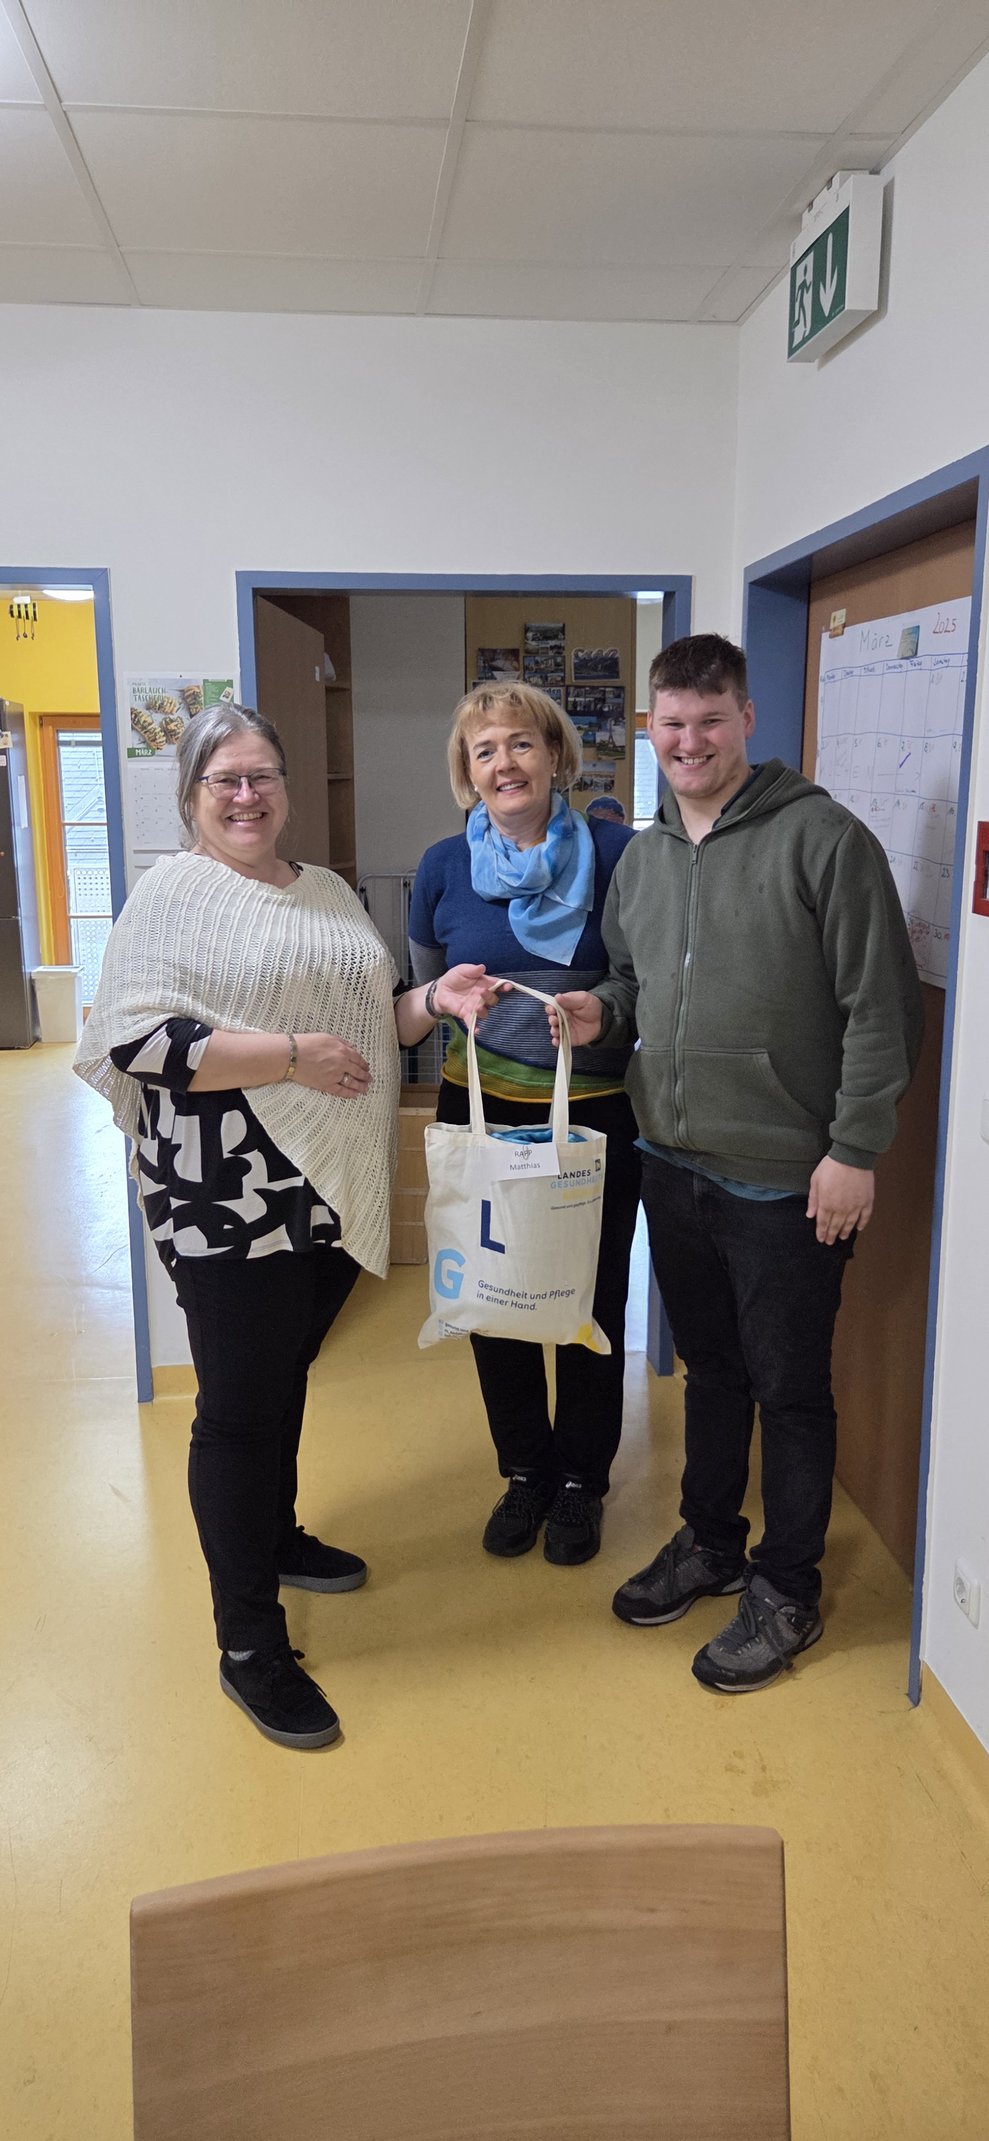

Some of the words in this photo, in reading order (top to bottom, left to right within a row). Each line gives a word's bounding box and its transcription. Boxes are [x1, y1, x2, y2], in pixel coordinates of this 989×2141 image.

[509, 1162, 541, 1171] Matthias
[480, 1199, 506, 1255] L
[434, 1248, 466, 1299] G
[476, 1290, 484, 1299] in
[486, 1294, 508, 1307] einer
[510, 1300, 537, 1311] Hand.
[478, 1280, 528, 1299] Gesundheit
[530, 1291, 548, 1300] und
[549, 1288, 576, 1301] Pflege
